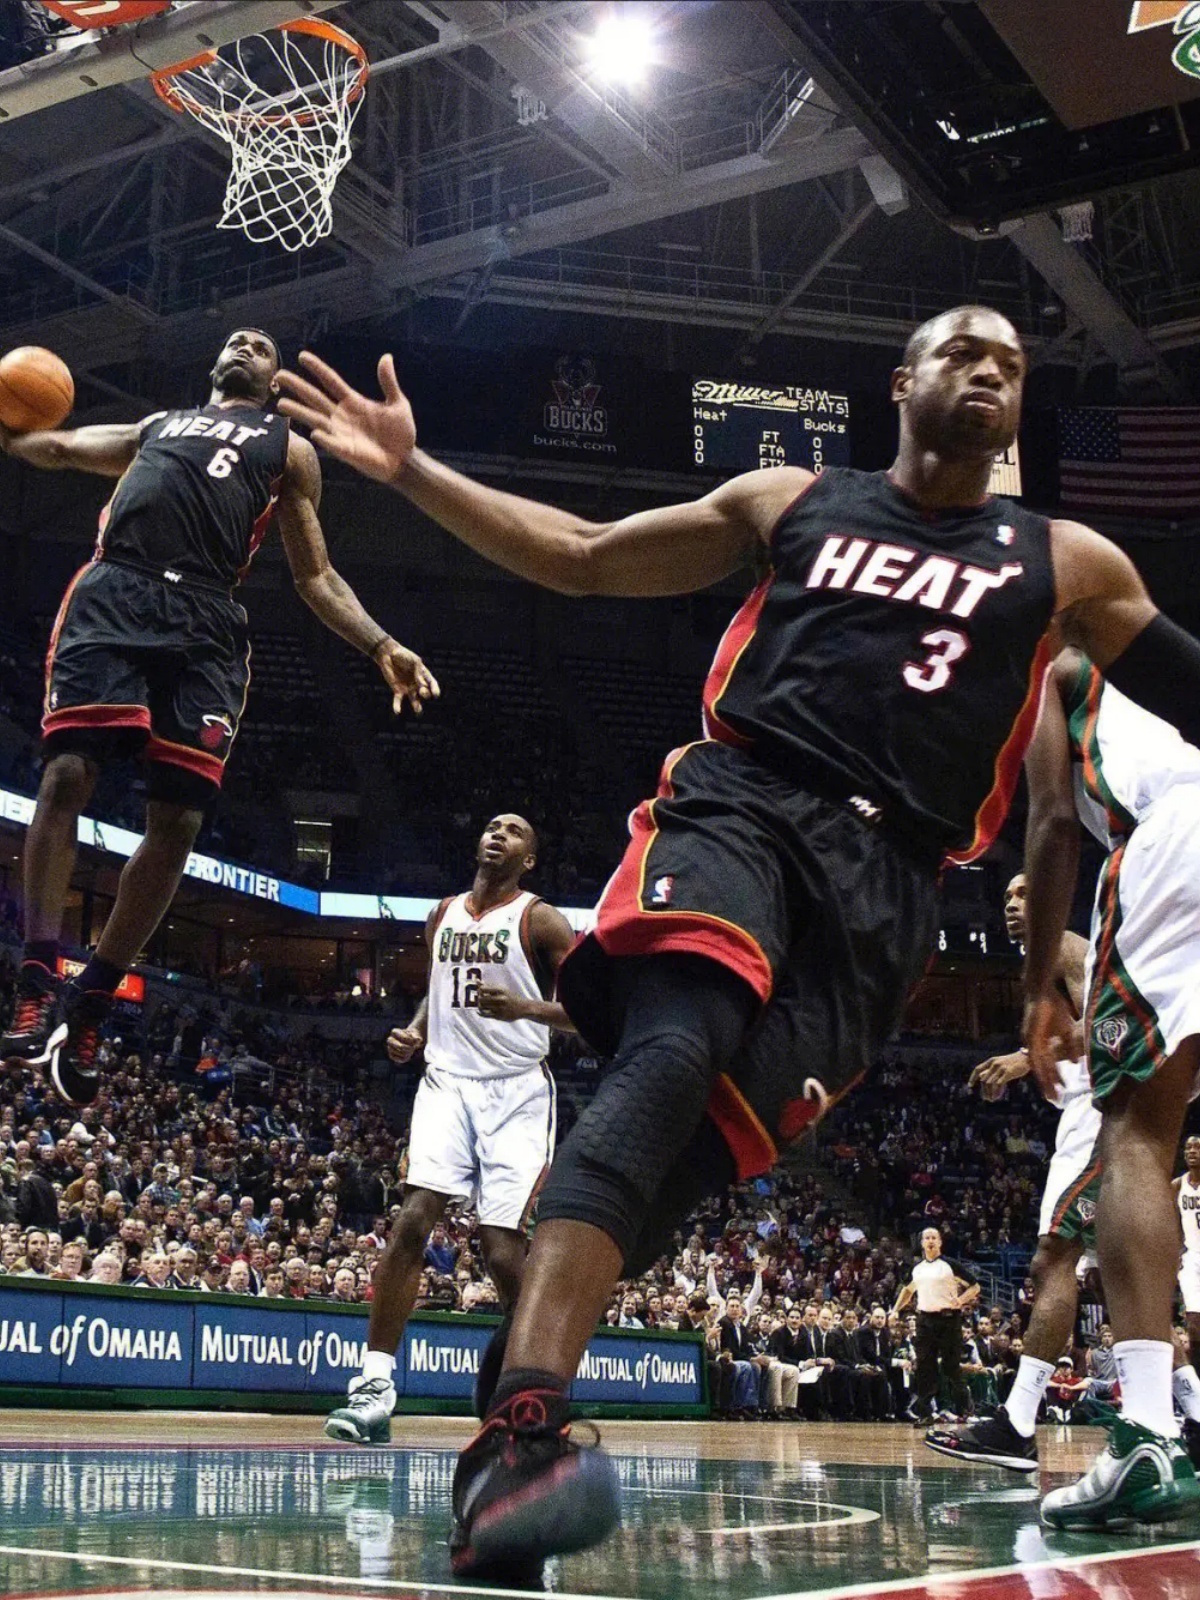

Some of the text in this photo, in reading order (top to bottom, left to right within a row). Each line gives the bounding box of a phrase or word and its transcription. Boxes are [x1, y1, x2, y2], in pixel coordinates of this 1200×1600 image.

[786, 387, 829, 402] TEAM
[158, 416, 269, 447] HEAT
[550, 405, 604, 433] BUCKS
[693, 407, 846, 434] Heat Bucks
[533, 434, 617, 454] bucks.com
[758, 445, 785, 457] FTA
[762, 431, 780, 443] FT
[206, 447, 239, 479] 6
[805, 535, 1024, 619] HEAT
[902, 628, 969, 693] 3
[186, 853, 280, 902] FRONTIER
[438, 927, 511, 964] BUCKS
[451, 966, 483, 1009] 12
[50, 1315, 87, 1366] of
[88, 1317, 182, 1361] OMAHA
[201, 1324, 293, 1365] MUTUAL
[298, 1330, 324, 1375] of
[410, 1338, 480, 1373] MUTUAL
[576, 1349, 697, 1389] MUTUAL of OMAHA
